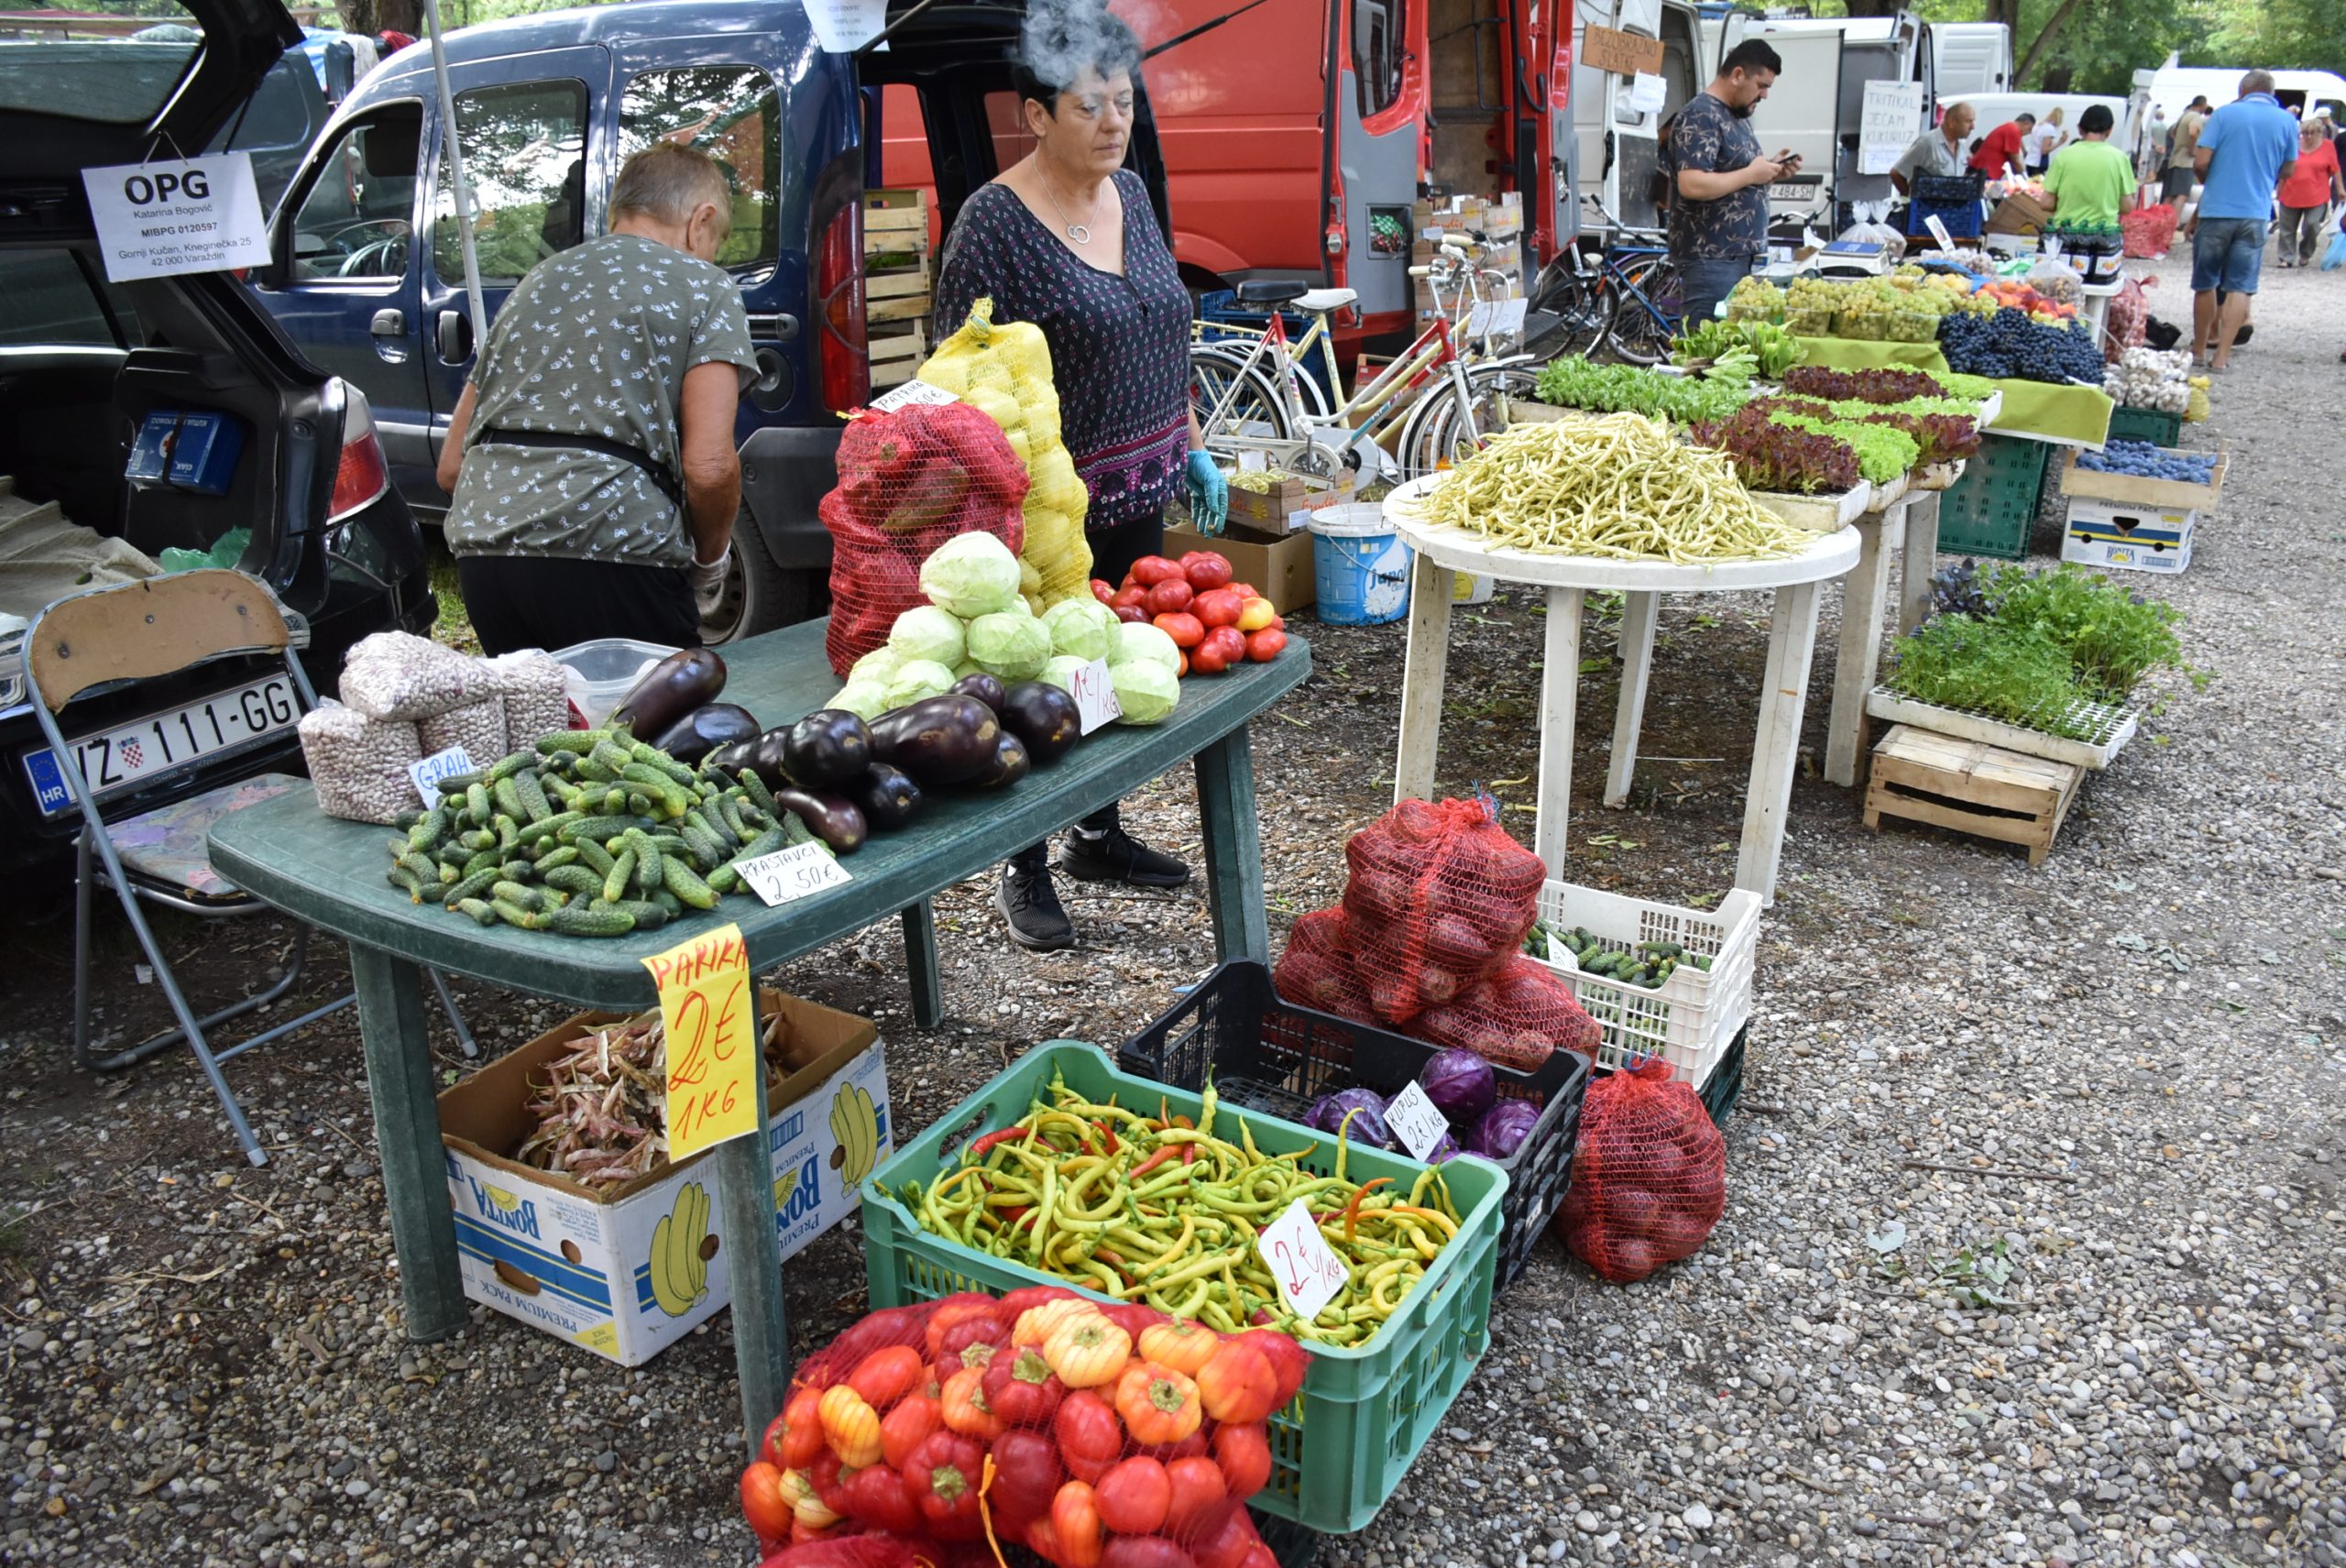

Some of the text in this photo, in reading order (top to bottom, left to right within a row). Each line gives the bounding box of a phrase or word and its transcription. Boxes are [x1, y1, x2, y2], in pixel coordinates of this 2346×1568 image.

[1866, 92, 1917, 110] TRITIKAL
[1866, 130, 1914, 144] KUKURUZ
[125, 170, 210, 205] OPG
[134, 204, 214, 220] Katarina Bogović
[141, 222, 218, 238] MIBPG 0120597
[118, 247, 148, 259] Gornji
[184, 239, 238, 255] Kneginečka
[240, 237, 252, 247] 25
[151, 251, 225, 267] 42 000 Varaždin
[905, 389, 942, 406] 50€
[2099, 501, 2159, 513] PREMIUM PACK
[418, 753, 469, 791] GRAH
[42, 785, 63, 804] HR
[740, 846, 817, 878] KRASTAVCI
[668, 980, 742, 1091] 2€
[1387, 1090, 1419, 1129] KUPUS
[775, 1142, 815, 1175] PREMIUM
[776, 1154, 821, 1234] BON
[466, 1175, 542, 1240] BONITA
[481, 1279, 511, 1304] PACK
[515, 1299, 578, 1333] PREMIUM
